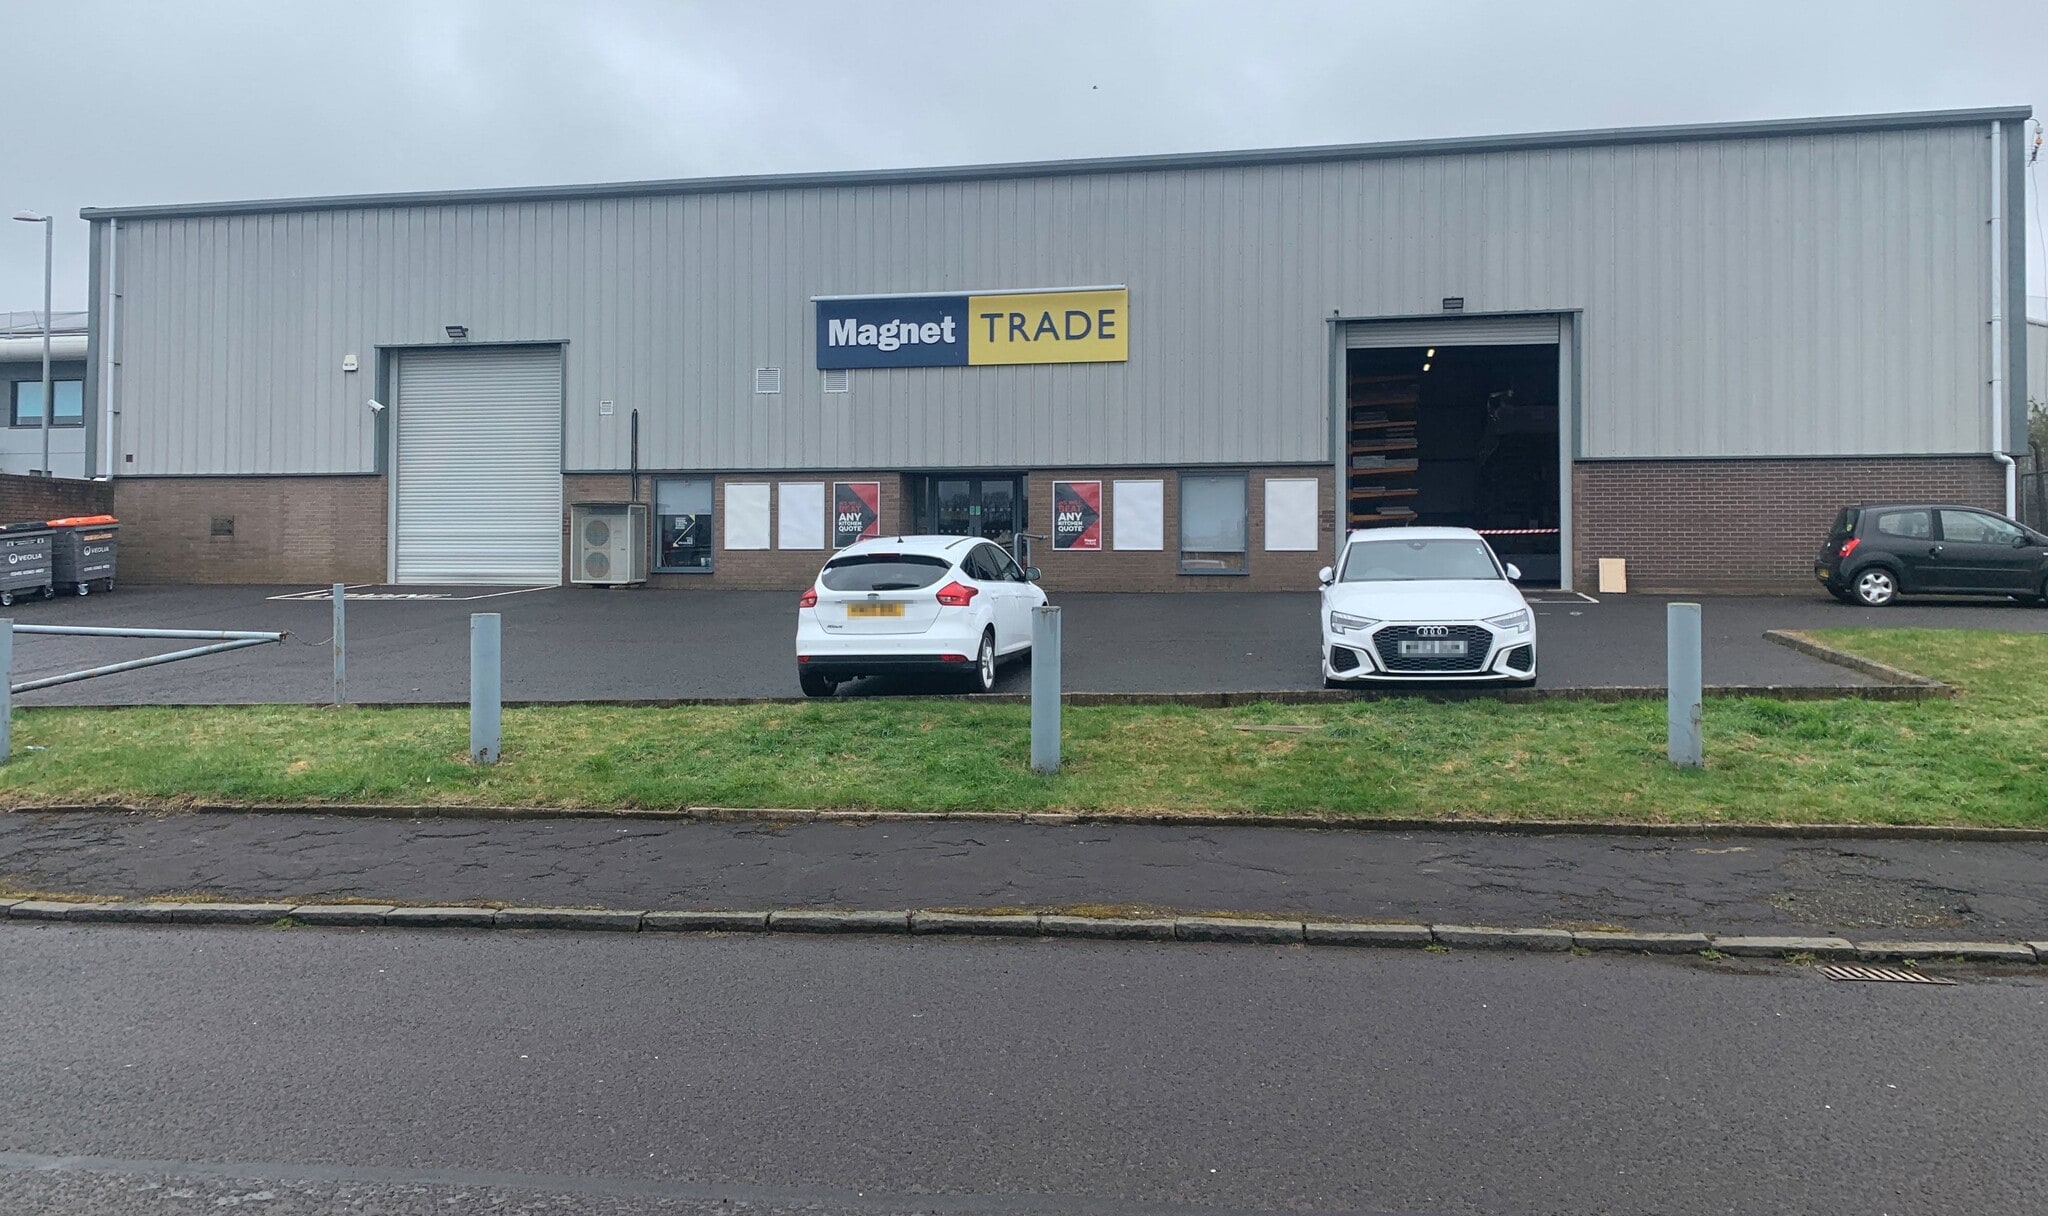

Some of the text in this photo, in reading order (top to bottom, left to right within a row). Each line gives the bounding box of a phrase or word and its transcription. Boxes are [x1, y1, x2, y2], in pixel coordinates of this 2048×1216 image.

[828, 309, 1115, 351] Magnet TRADE
[839, 512, 861, 521] ANY
[1058, 512, 1082, 521] ANY
[91, 546, 109, 554] VEOLIA
[18, 553, 42, 561] VEOLIA
